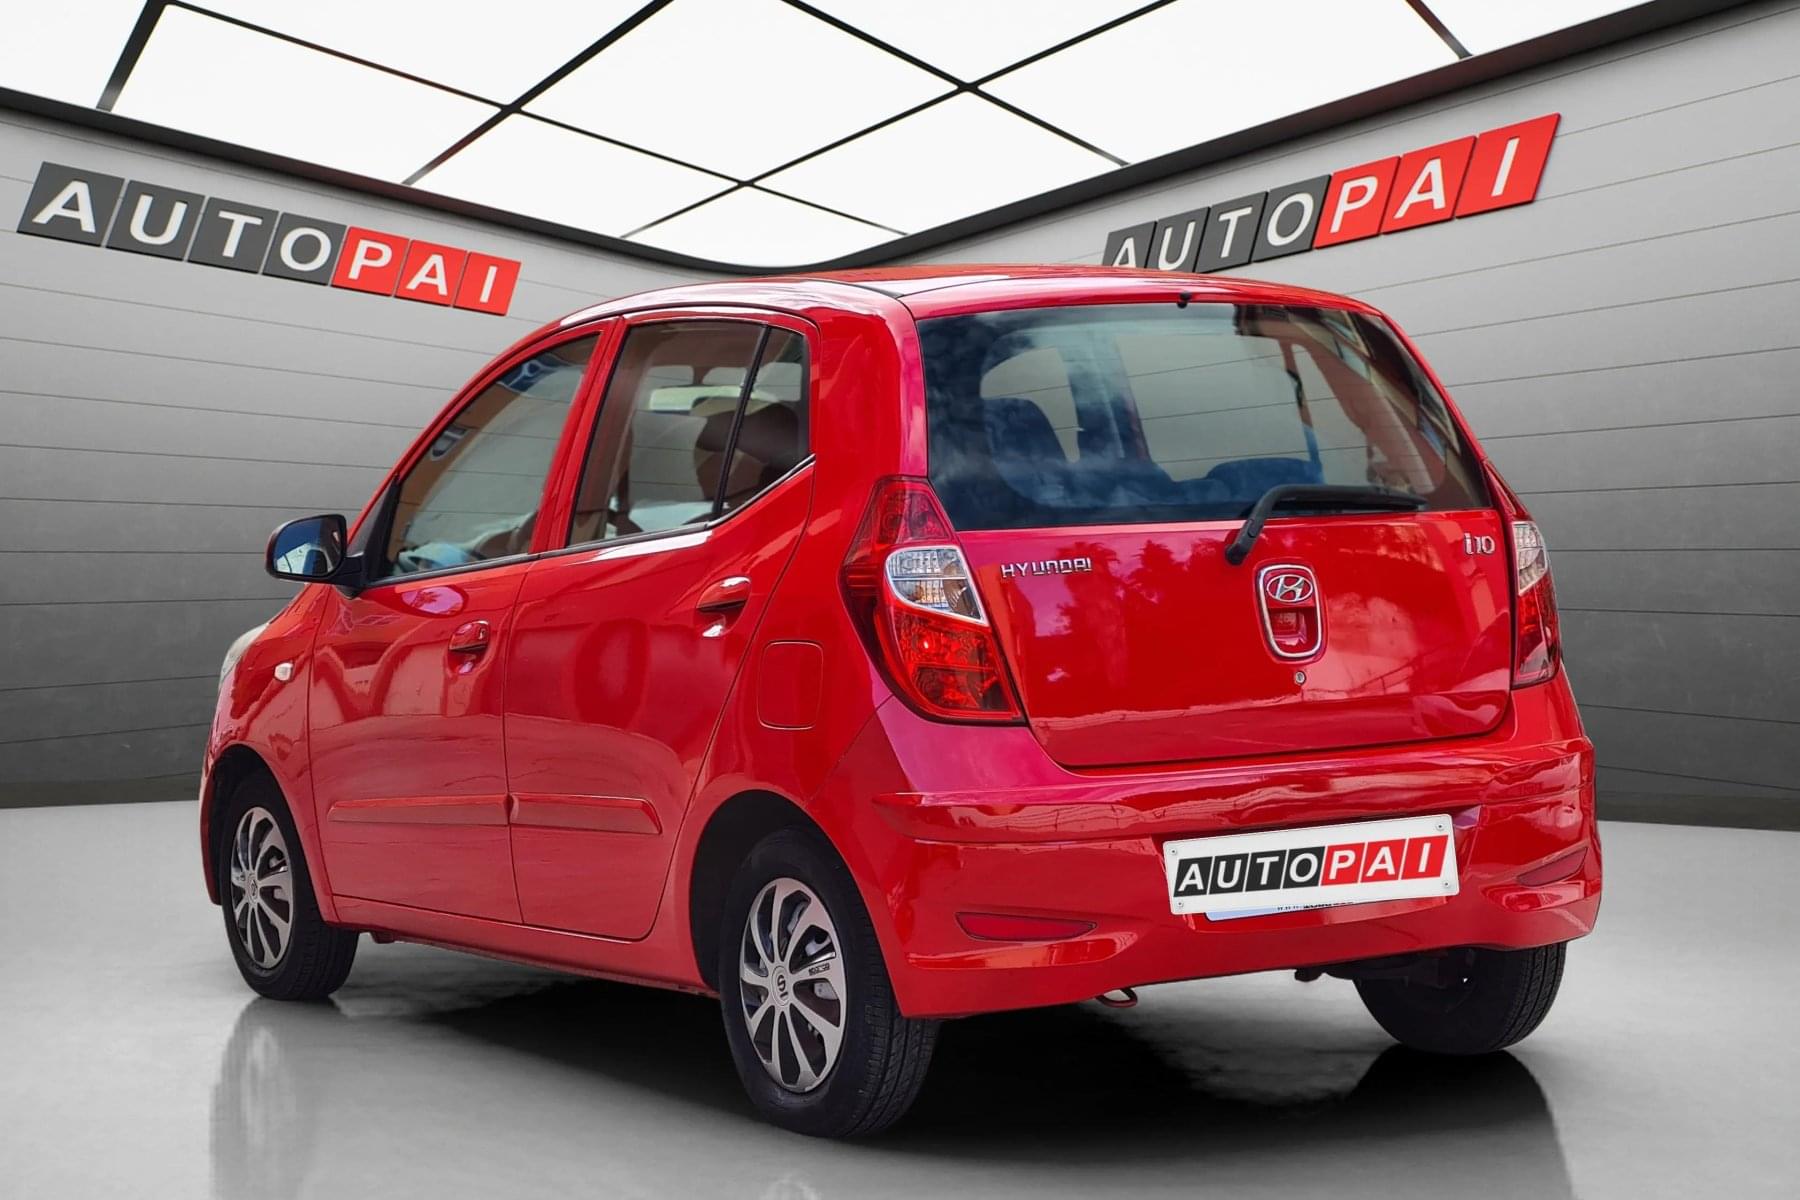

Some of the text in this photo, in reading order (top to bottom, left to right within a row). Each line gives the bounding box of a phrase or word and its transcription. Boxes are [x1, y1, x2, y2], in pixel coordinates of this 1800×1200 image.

[32, 180, 497, 304] AUTOPAI
[1111, 137, 1519, 271] AUTOPAI
[1001, 557, 1093, 578] HYUNDAI
[1178, 842, 1431, 892] AUTOPAI
